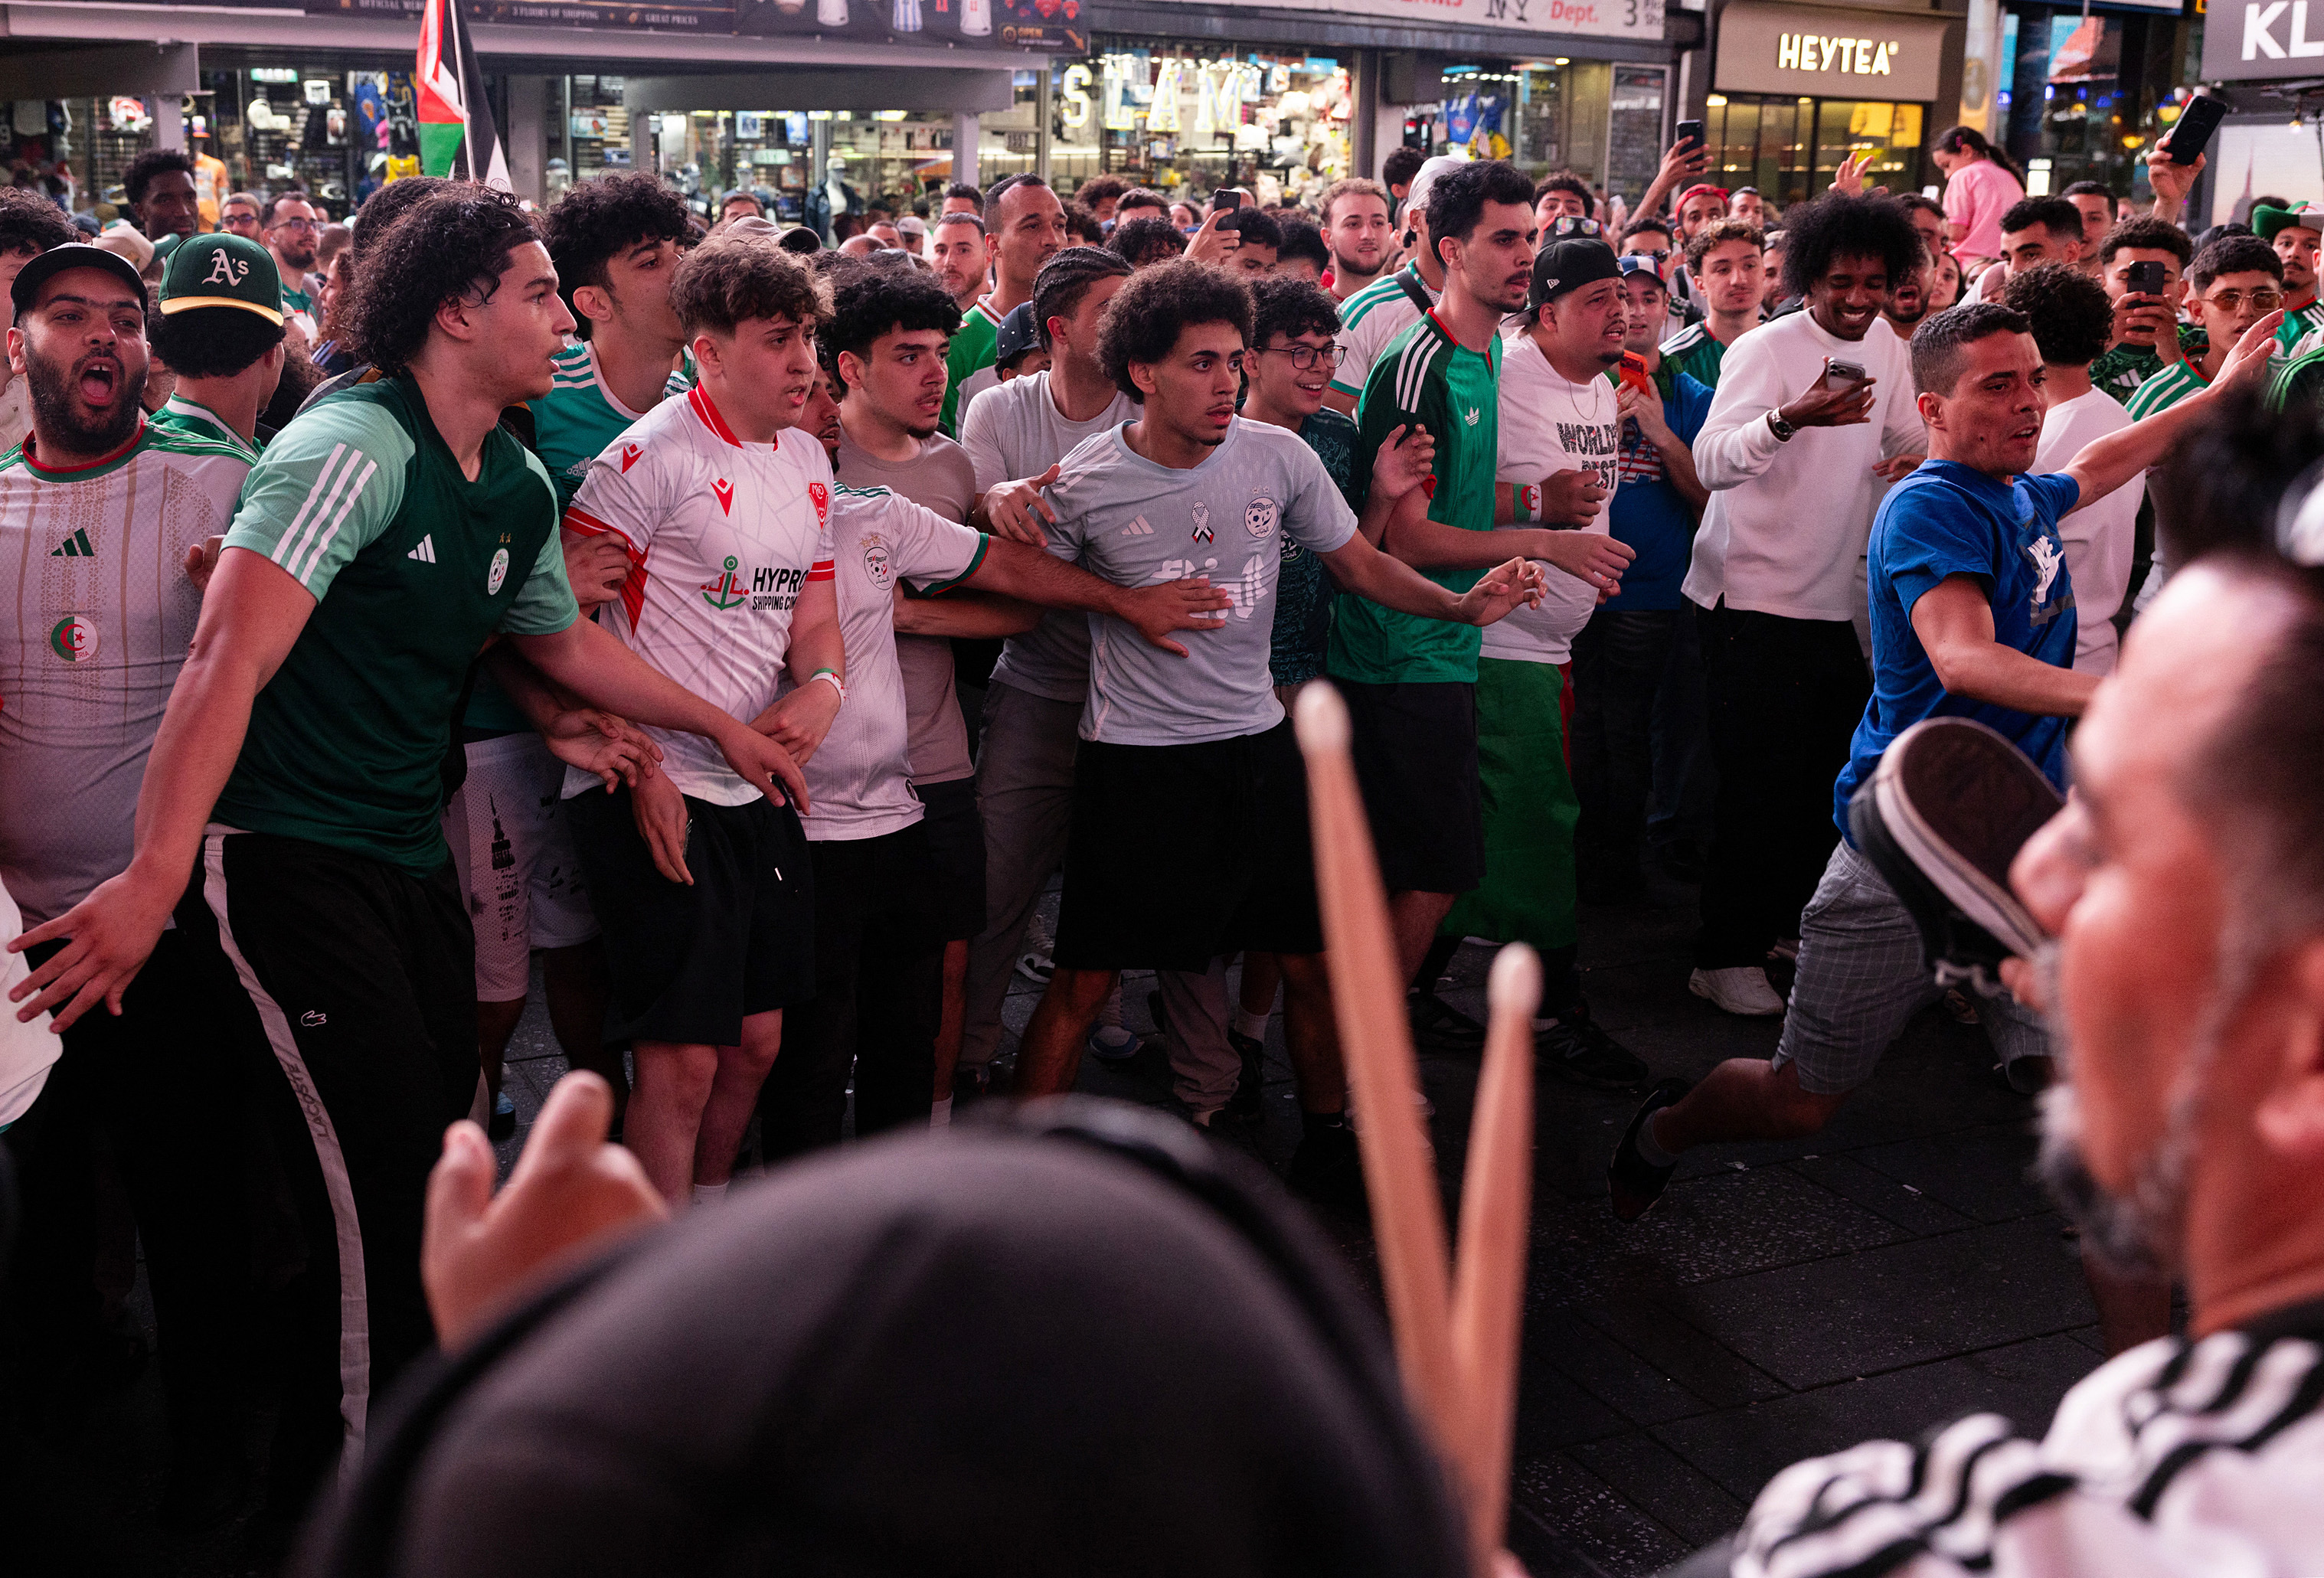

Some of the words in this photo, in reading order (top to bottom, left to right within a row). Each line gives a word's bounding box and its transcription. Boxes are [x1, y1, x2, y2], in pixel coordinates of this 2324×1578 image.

[519, 7, 549, 18] FLOORS
[550, 8, 561, 18] OF
[562, 9, 600, 21] SHOPPING
[645, 14, 670, 24] GREAT
[671, 15, 698, 25] PRICES
[1551, 1, 1598, 27] Dept.
[1018, 28, 1043, 38] OPEN
[2241, 1, 2324, 61] KL
[1062, 63, 1246, 132] SLAM
[201, 248, 250, 287] A's
[752, 596, 784, 611] SHIPPING
[289, 1063, 330, 1139] LACOSTE
